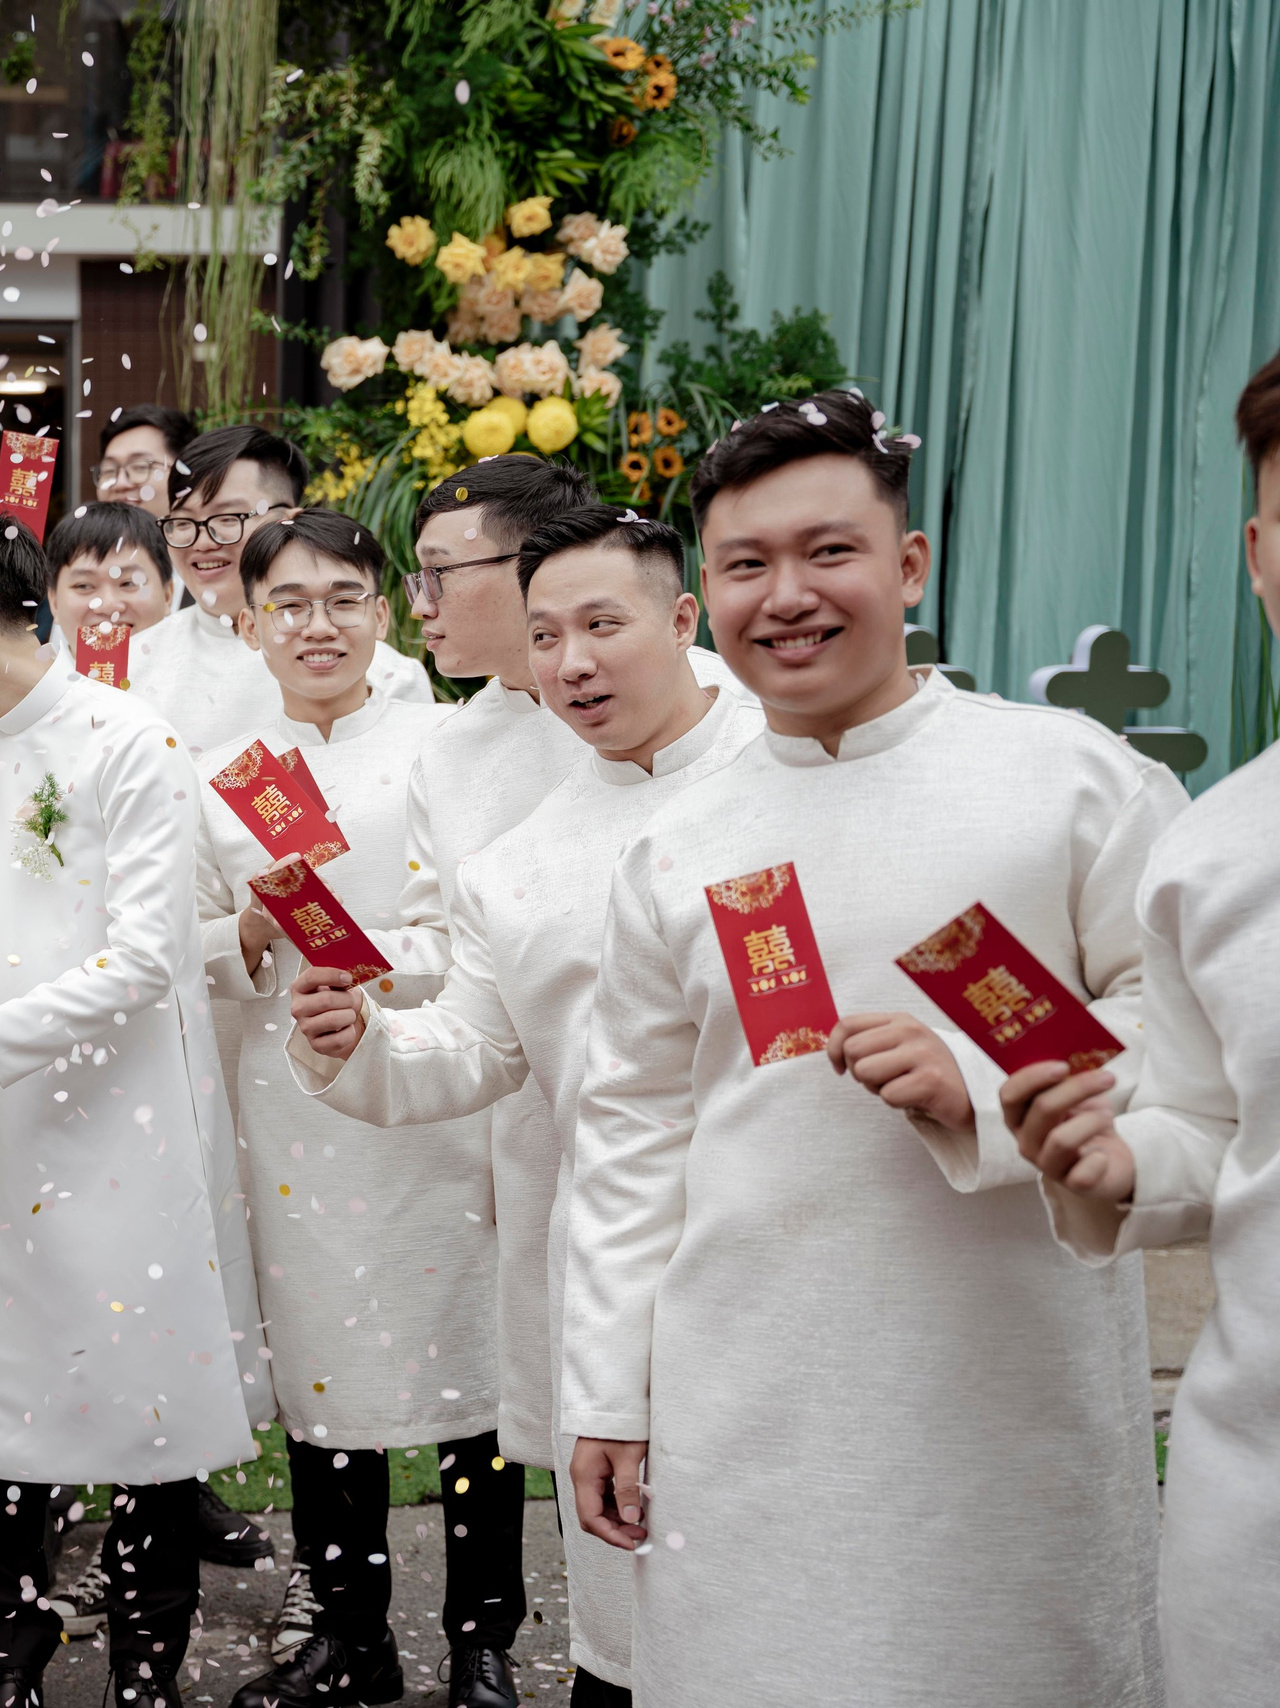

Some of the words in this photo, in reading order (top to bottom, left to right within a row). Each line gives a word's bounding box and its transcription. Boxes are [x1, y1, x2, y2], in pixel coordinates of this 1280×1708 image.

[10, 468, 38, 496] 囍
[251, 784, 292, 825] 囍
[290, 901, 335, 937] 囍
[742, 924, 797, 976] 囍
[961, 964, 1033, 1026] 囍
